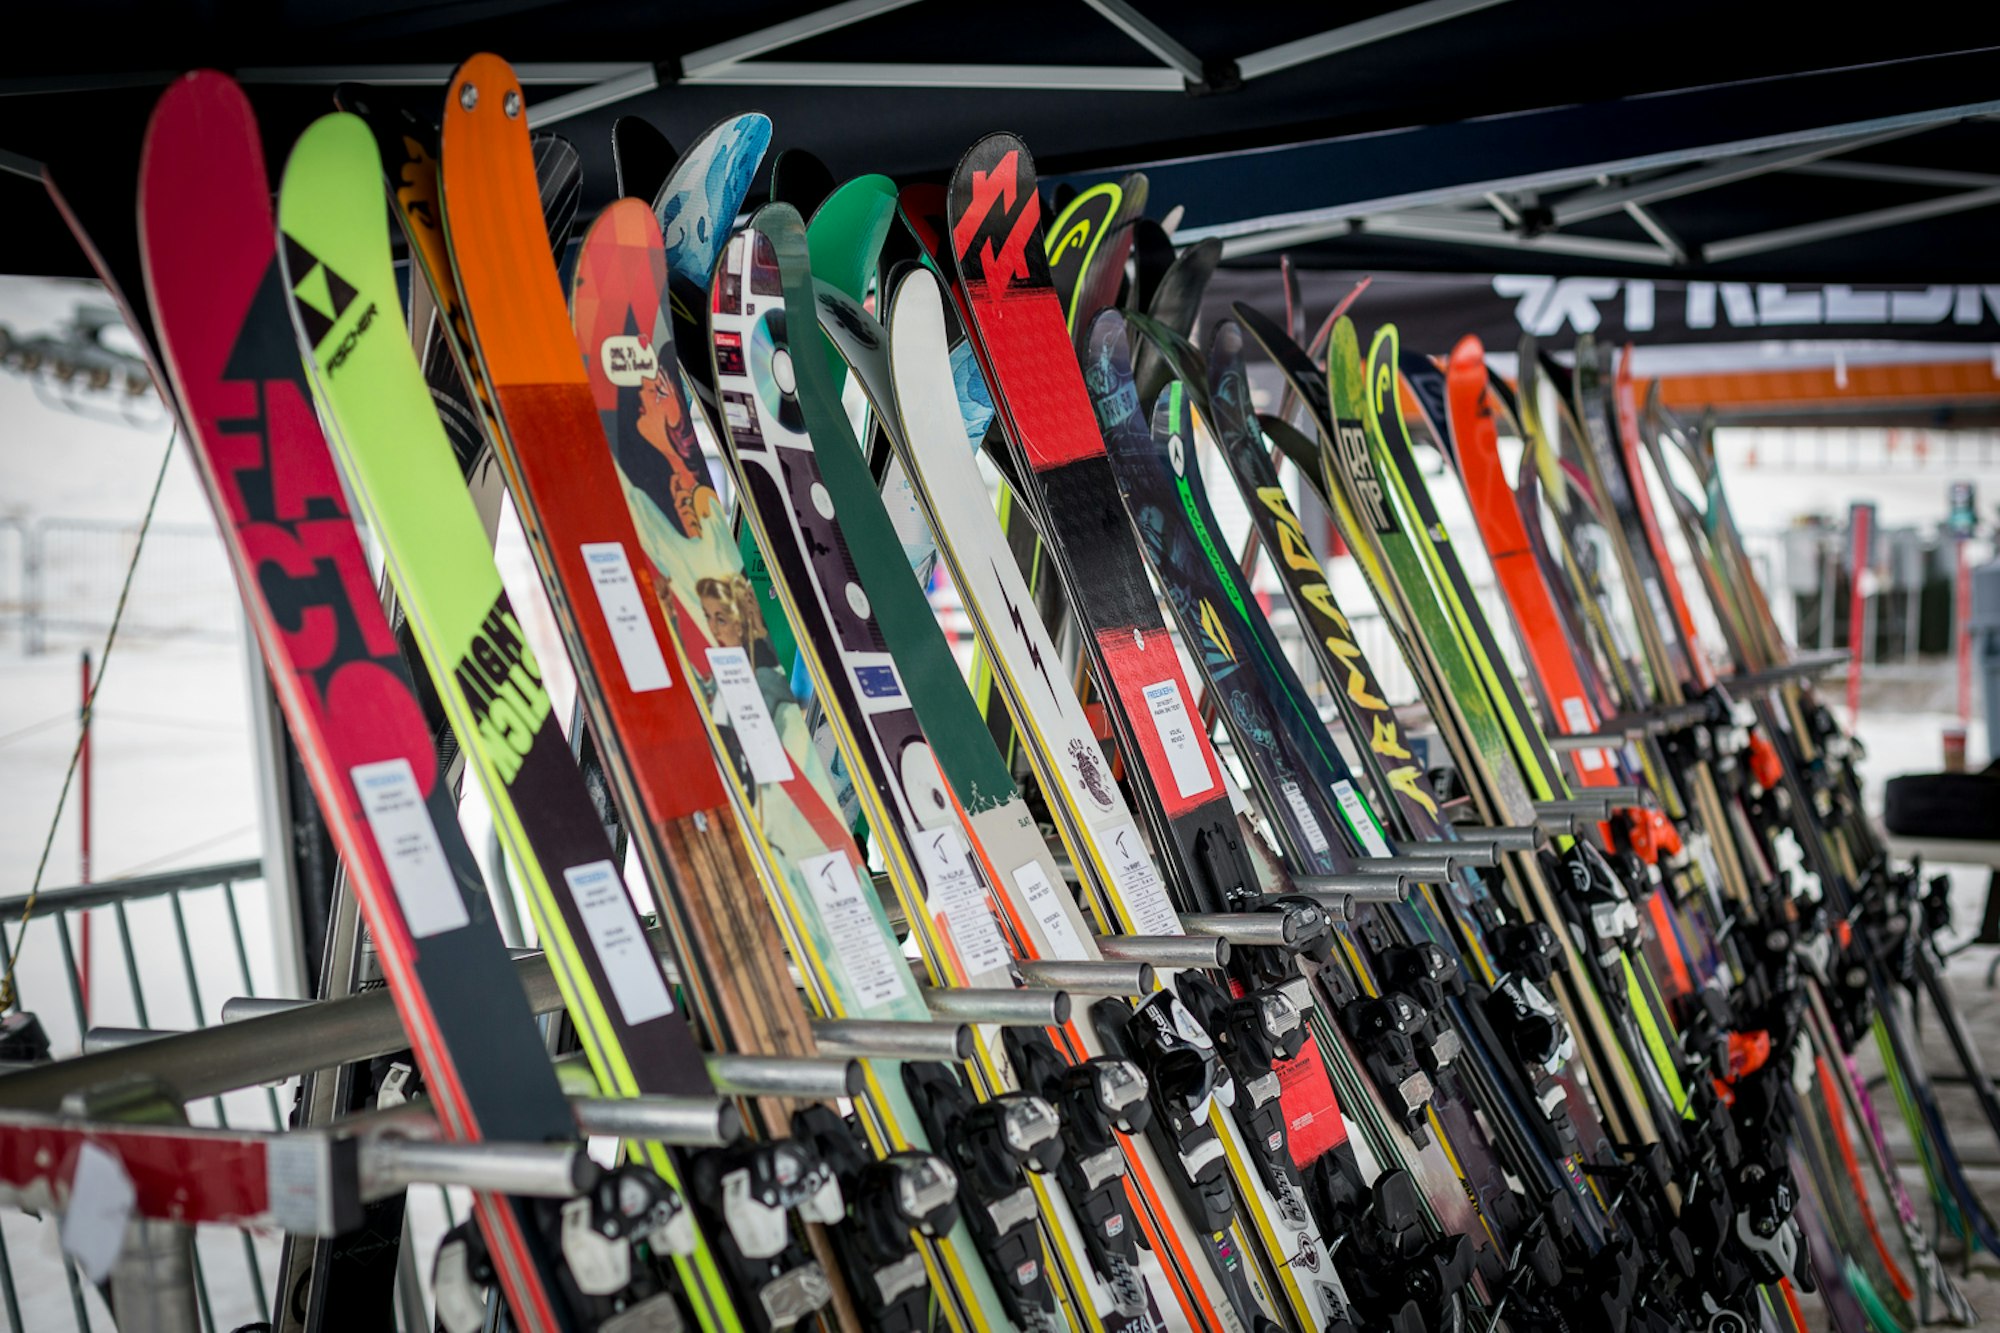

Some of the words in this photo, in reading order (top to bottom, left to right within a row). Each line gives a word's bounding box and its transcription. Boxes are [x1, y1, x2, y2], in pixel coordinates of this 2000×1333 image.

[326, 303, 378, 379] FISCHER
[1184, 493, 1239, 601] DYNASTAR
[1258, 487, 1439, 824] ARMADA
